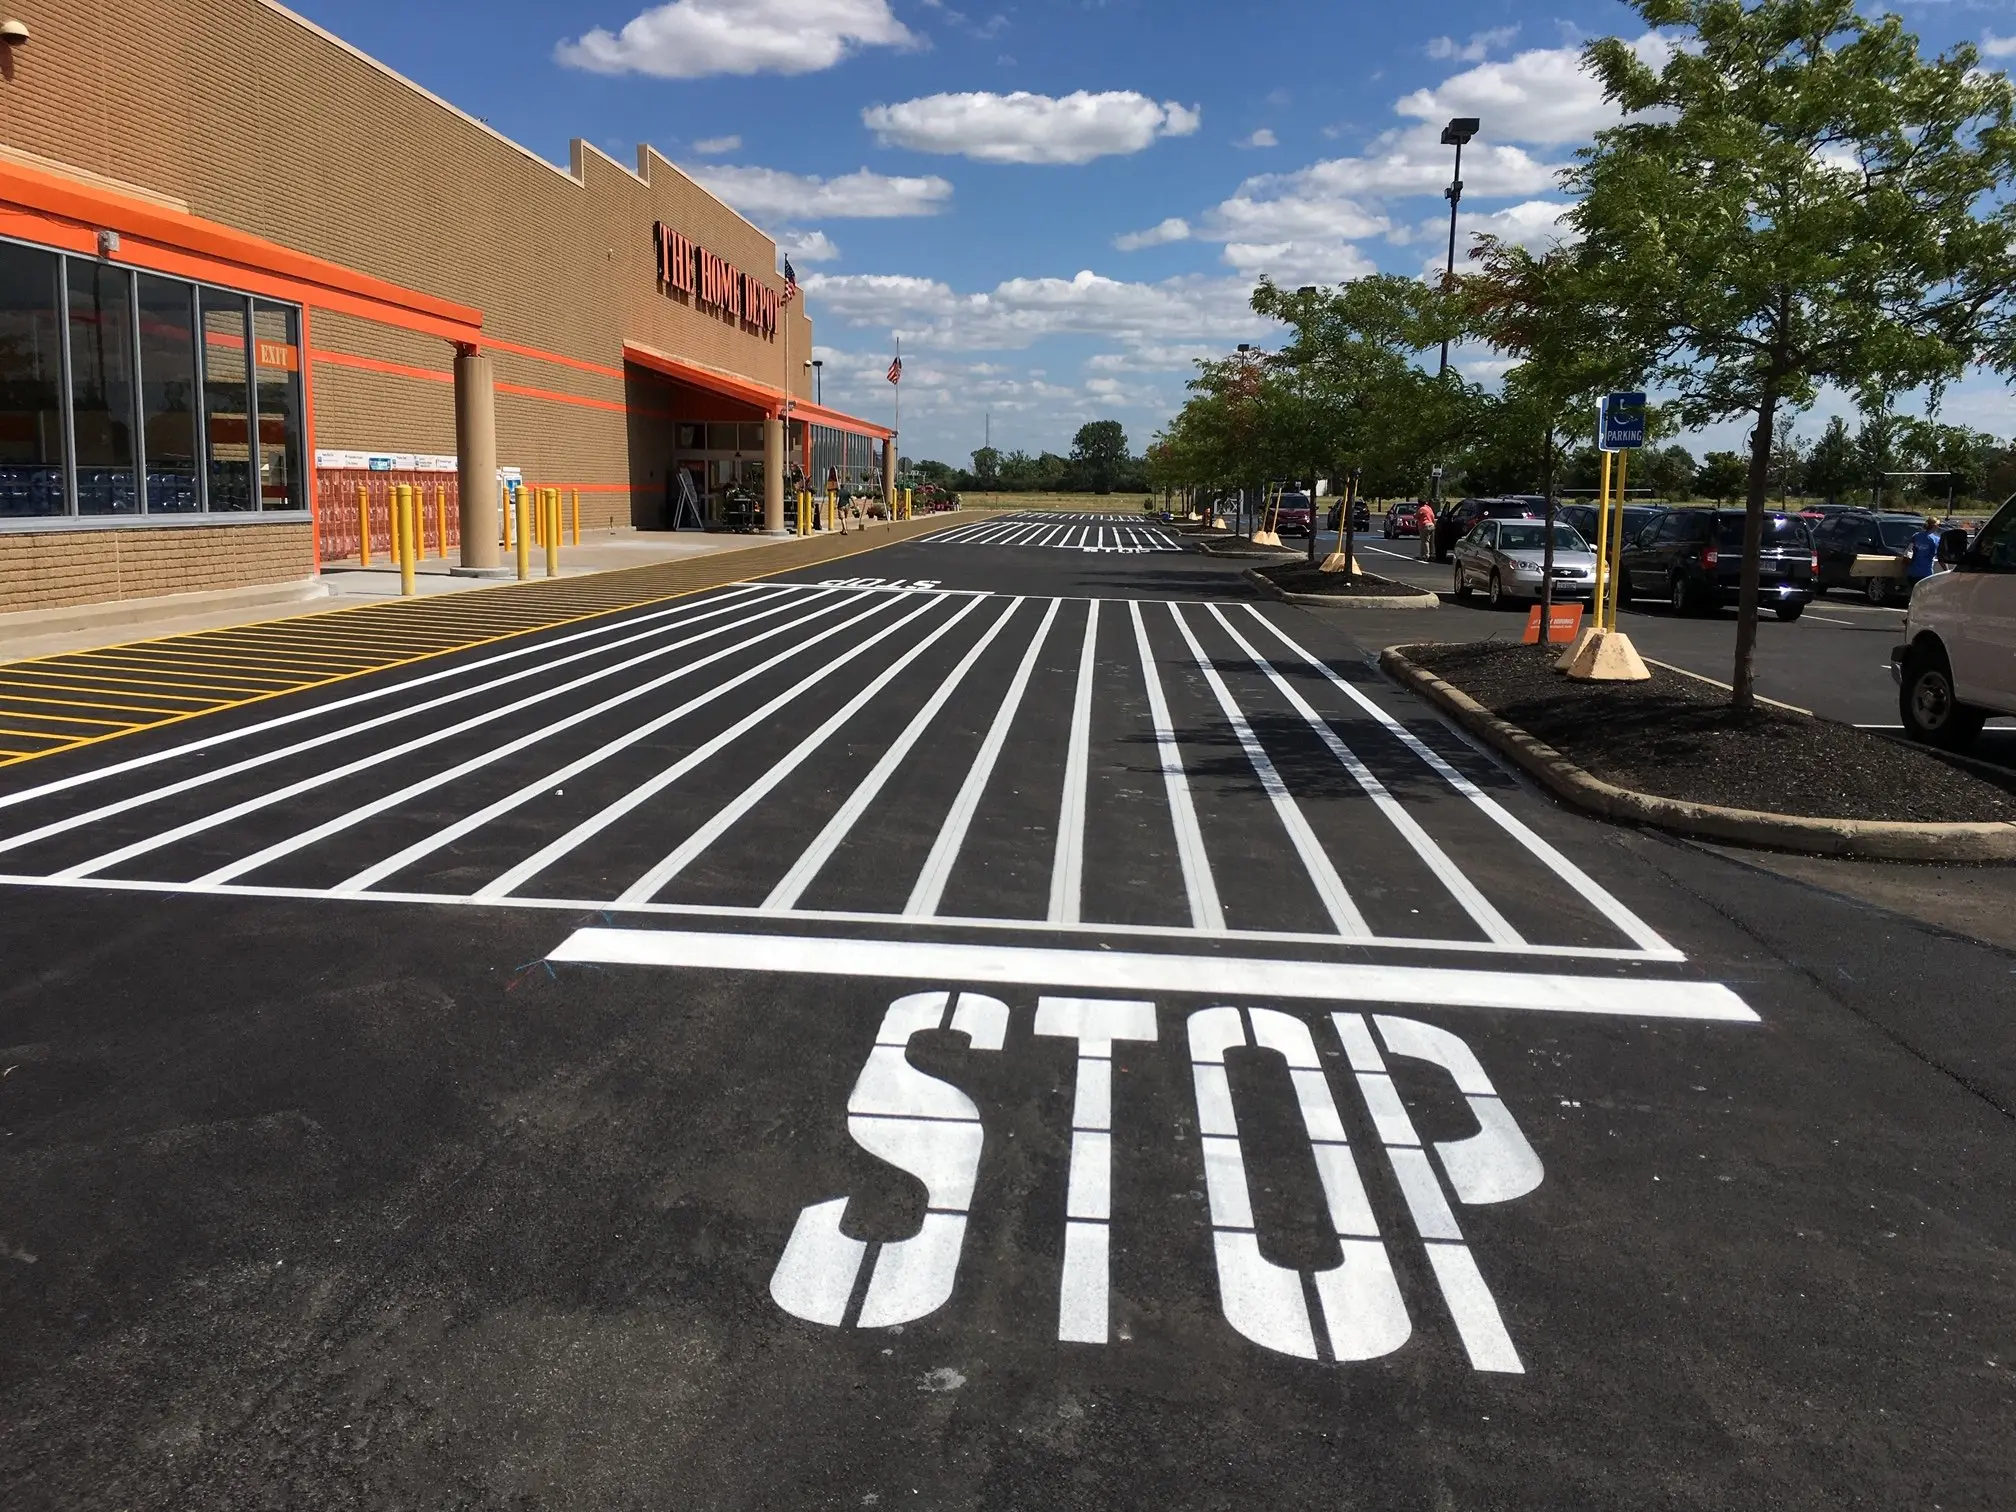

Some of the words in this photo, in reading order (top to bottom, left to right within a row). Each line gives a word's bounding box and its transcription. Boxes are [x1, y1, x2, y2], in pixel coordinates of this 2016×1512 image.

[656, 220, 694, 295] THE
[696, 246, 740, 317] HOME
[741, 272, 780, 335] DEPOT
[260, 344, 287, 366] EXIT
[1607, 430, 1642, 441] PARKING
[769, 991, 1545, 1373] STOP
